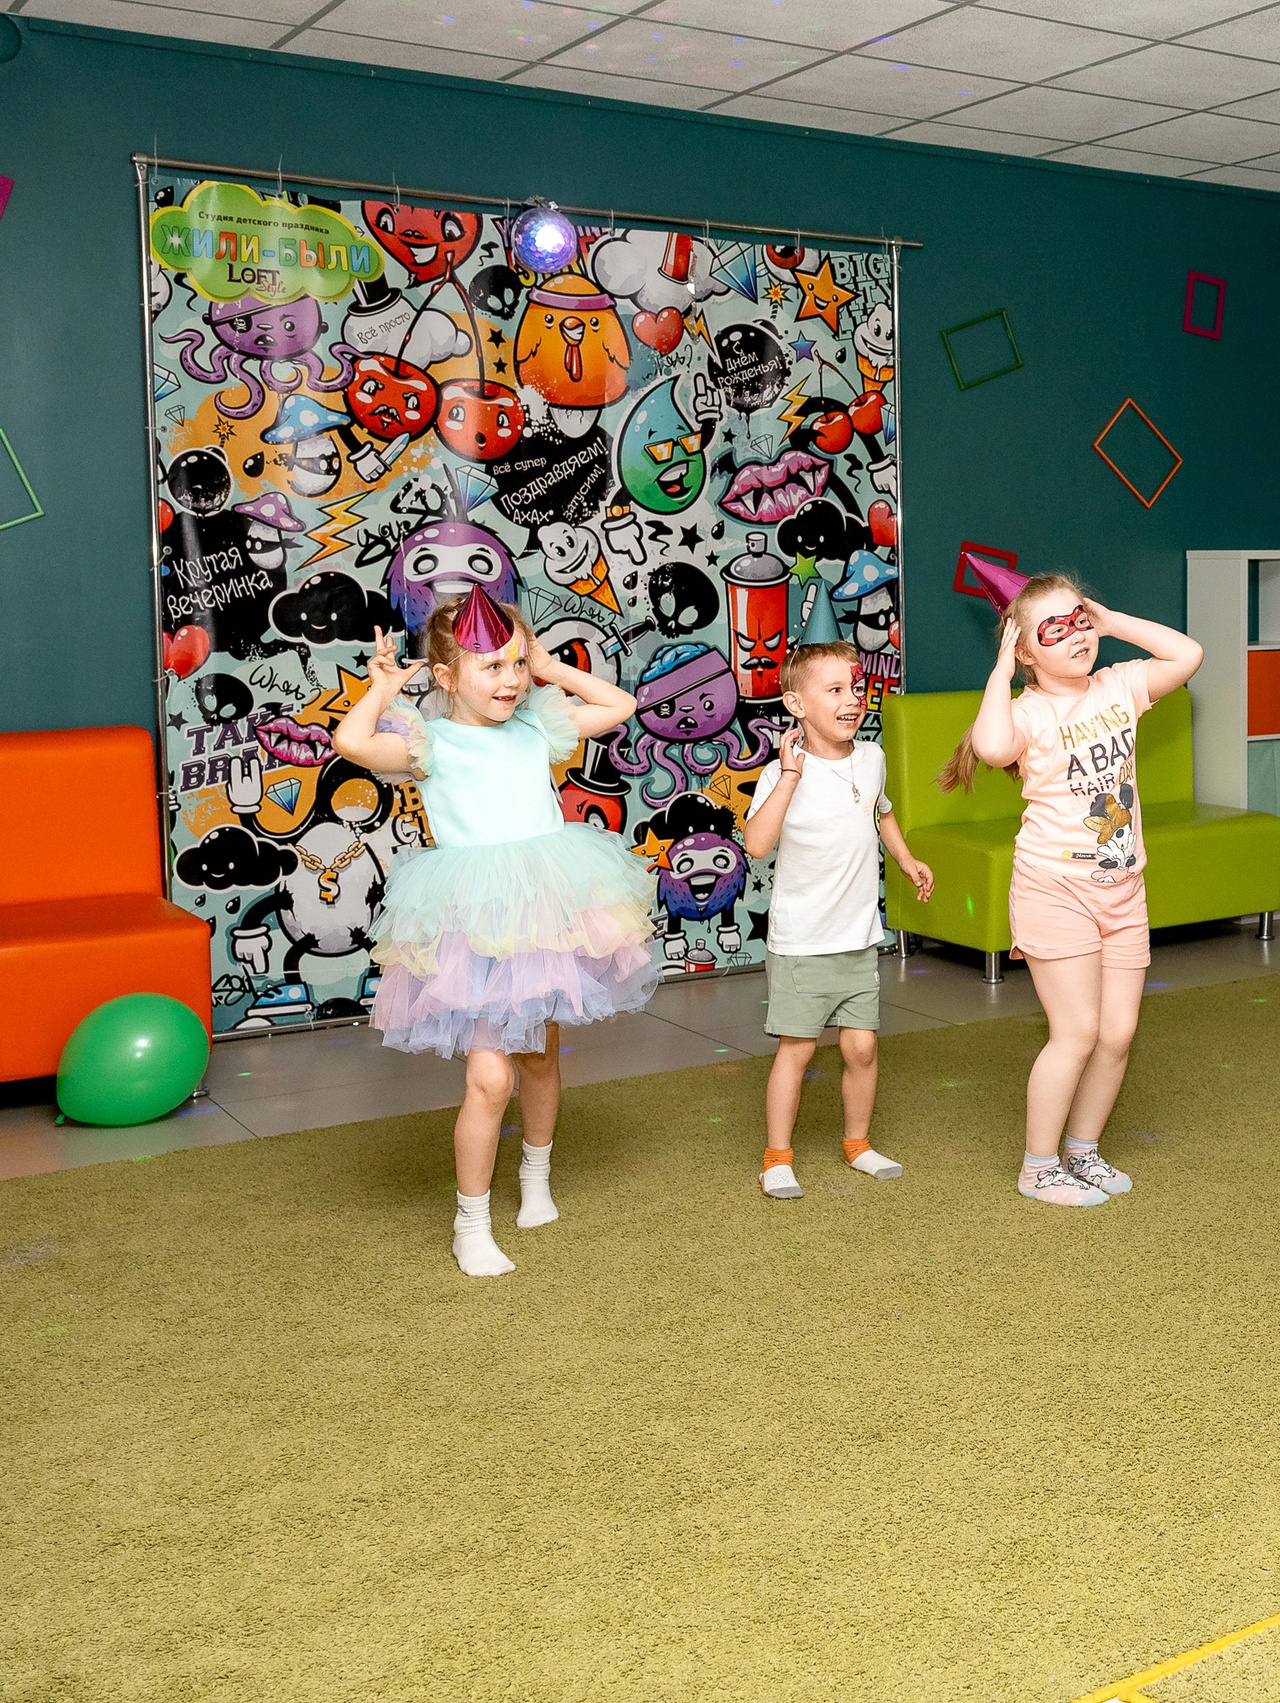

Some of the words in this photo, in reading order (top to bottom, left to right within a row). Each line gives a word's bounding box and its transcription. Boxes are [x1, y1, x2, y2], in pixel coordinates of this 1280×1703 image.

[198, 211, 234, 222] Студия
[236, 217, 279, 227] детского
[282, 222, 330, 235] праздника
[161, 224, 370, 273] ЖИЛИ-БЫЛИ
[227, 263, 280, 286] LOFT
[830, 253, 891, 285] BIG
[256, 281, 287, 297] Style
[378, 312, 411, 333] просто
[514, 457, 547, 471] супер
[172, 546, 244, 589] Крутая
[187, 703, 294, 757] TAK
[1067, 753, 1088, 780] A
[1089, 727, 1135, 774] BAD
[1119, 760, 1134, 786] DAY
